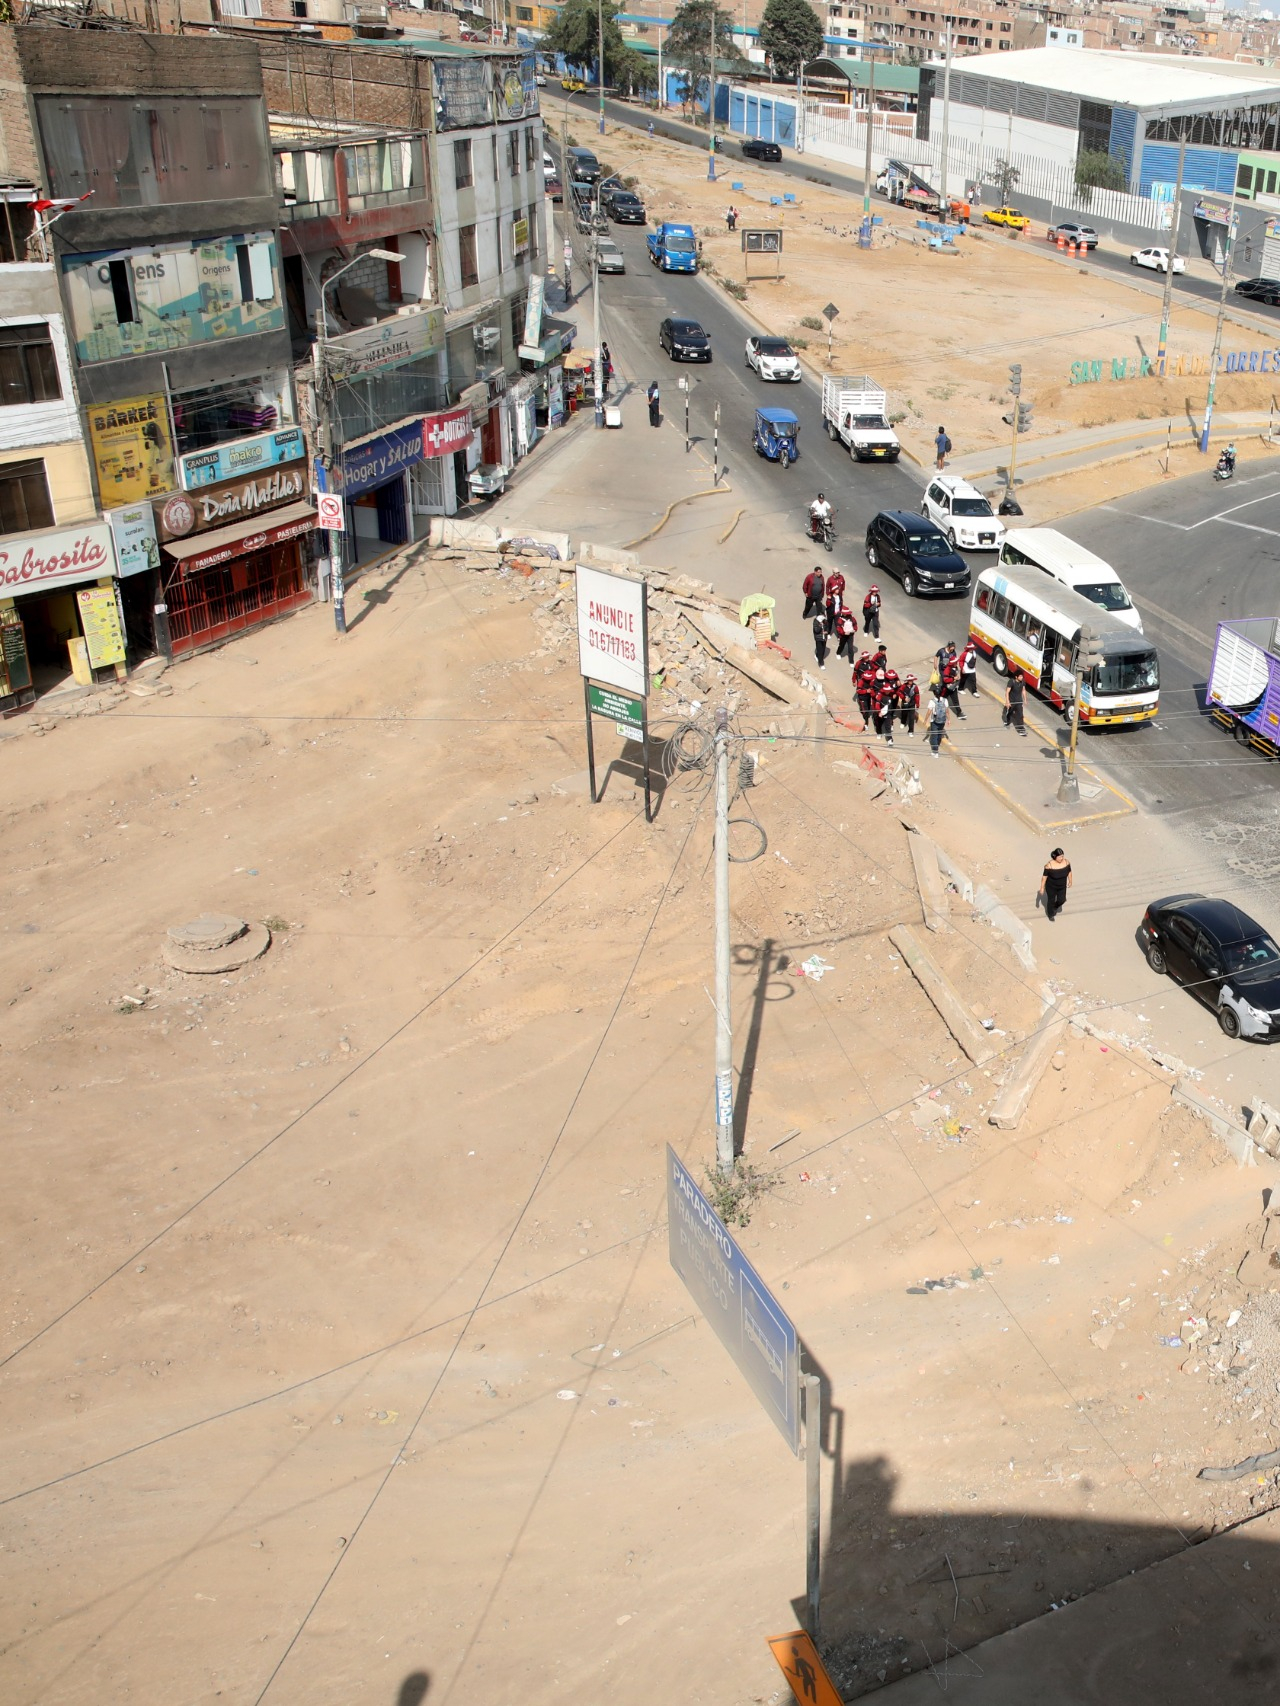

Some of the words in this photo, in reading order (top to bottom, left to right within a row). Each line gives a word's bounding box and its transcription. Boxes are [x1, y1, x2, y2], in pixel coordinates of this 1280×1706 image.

[202, 263, 231, 276] Origens
[1069, 359, 1102, 385] SAN
[94, 405, 159, 432] BARKER
[275, 431, 298, 442] ADVANCE
[229, 446, 262, 463] makro
[344, 459, 377, 487] Hogar
[379, 455, 387, 475] y
[387, 437, 422, 467] SALUD
[200, 491, 241, 522] Doña
[242, 471, 296, 510] Matilde
[277, 521, 313, 539] PASTELERIA
[0, 536, 107, 590] Sabrosita
[195, 550, 232, 568] PANADERIA
[589, 600, 634, 633] ANUNCIE
[672, 1162, 732, 1260] PARADERO
[673, 1190, 736, 1295] TRANSPORTE
[680, 1227, 728, 1311] PUBLICO
